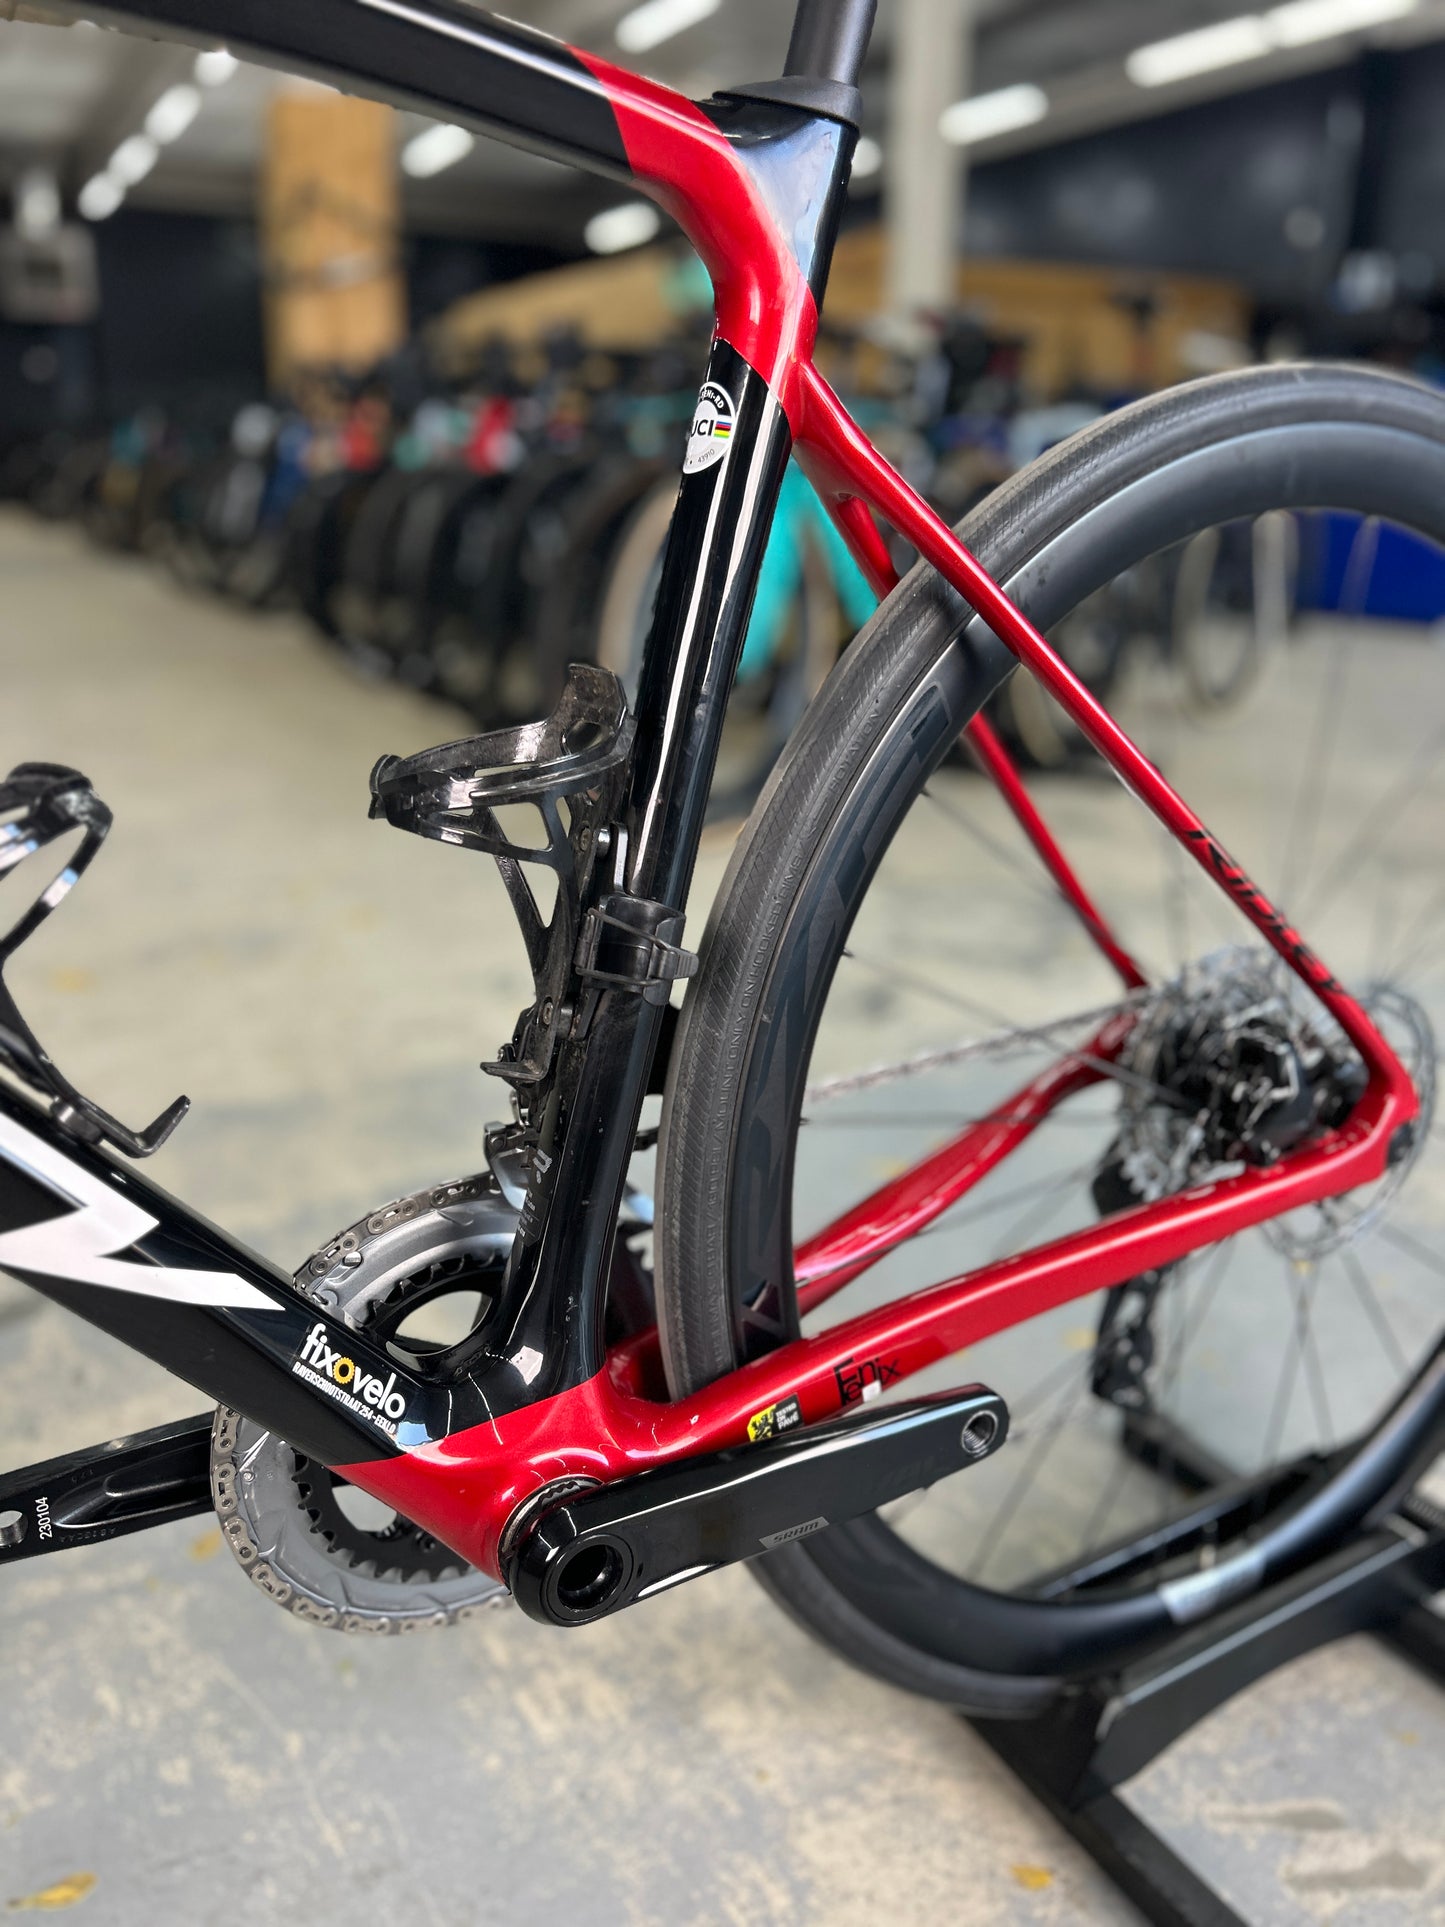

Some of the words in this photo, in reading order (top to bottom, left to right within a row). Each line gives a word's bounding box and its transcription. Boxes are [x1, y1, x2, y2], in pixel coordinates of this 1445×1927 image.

[698, 448, 715, 463] 43910
[728, 1012, 747, 1058] ONLY
[740, 980, 757, 1008] ON
[749, 899, 785, 978] HOOKED
[292, 1361, 362, 1413] RAVERSCHOOTSTRAAT
[300, 1323, 406, 1419] fixovelo
[833, 1356, 901, 1406] Fenix
[775, 1402, 797, 1418] TESTED
[776, 1414, 787, 1423] ON
[35, 1497, 53, 1540] 230104
